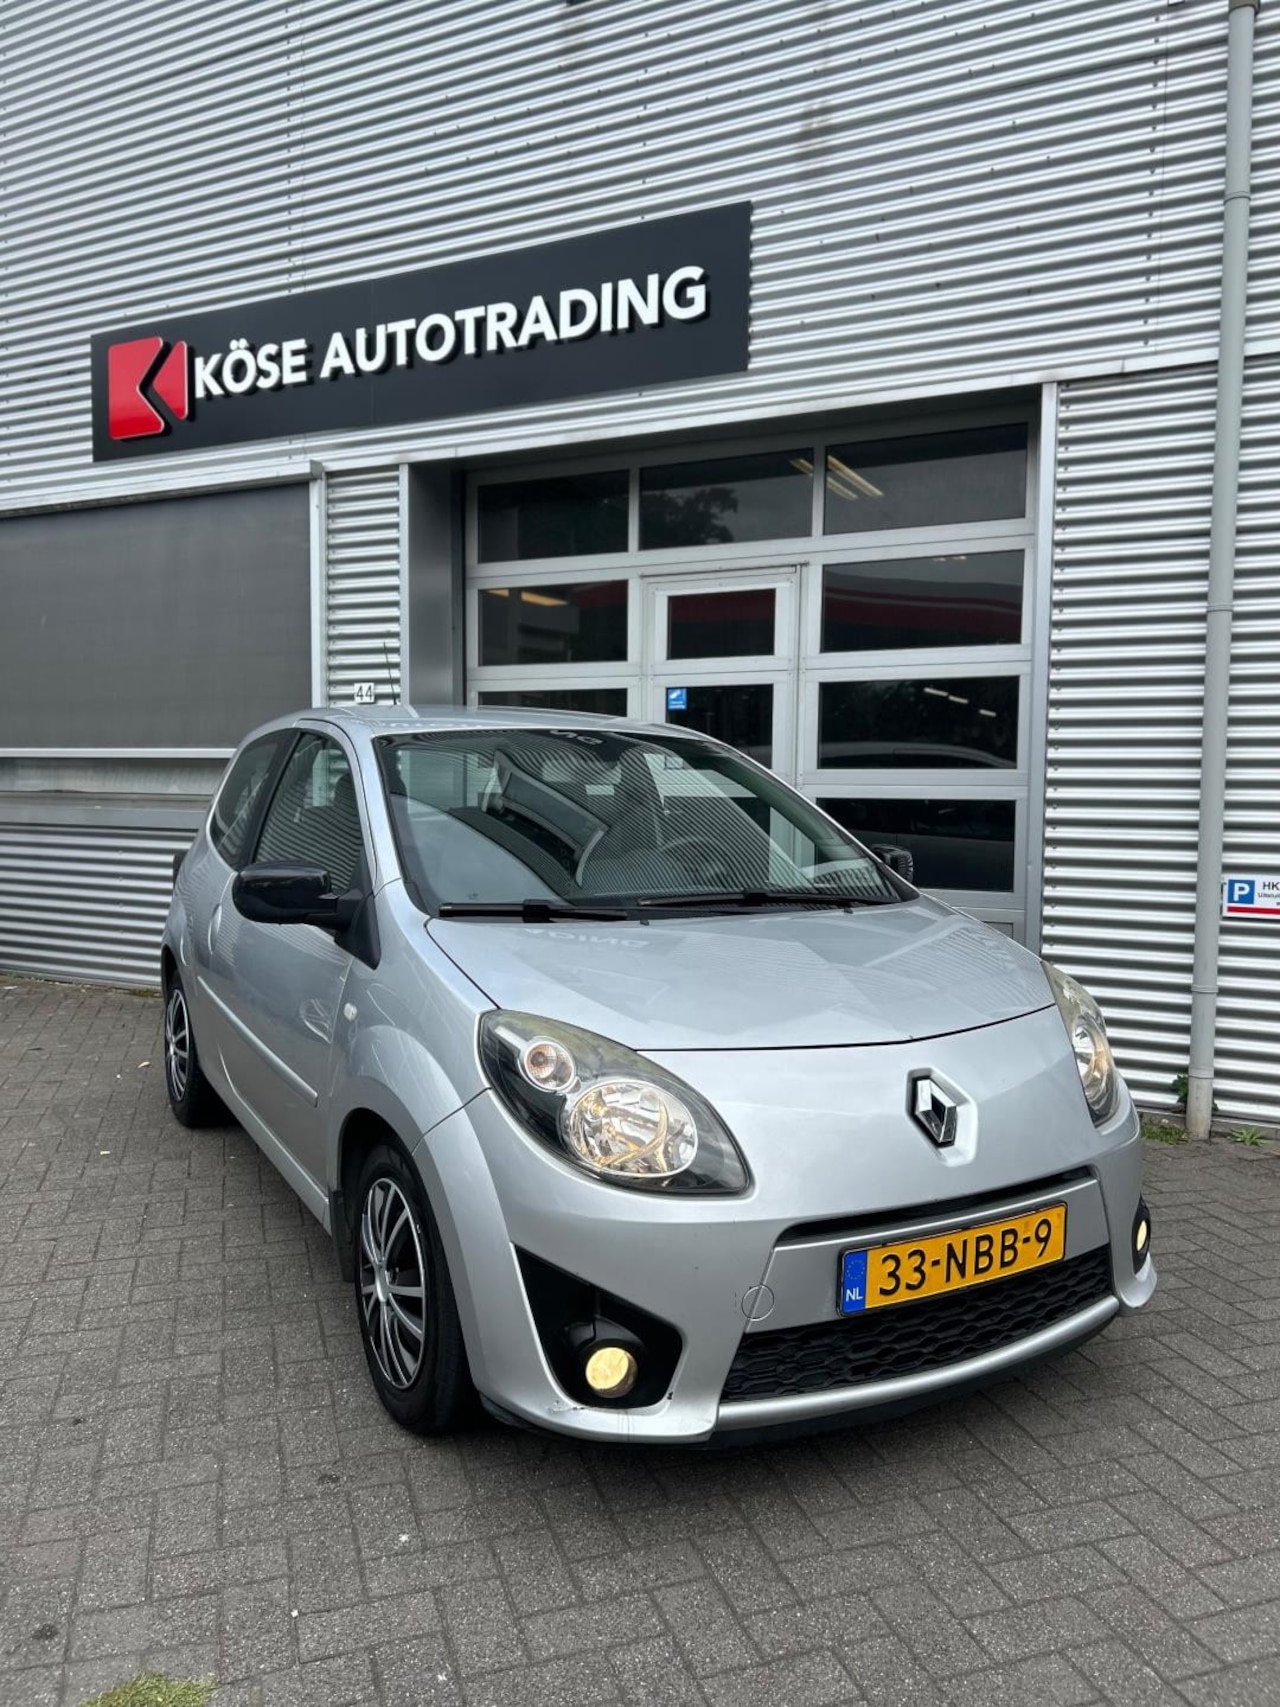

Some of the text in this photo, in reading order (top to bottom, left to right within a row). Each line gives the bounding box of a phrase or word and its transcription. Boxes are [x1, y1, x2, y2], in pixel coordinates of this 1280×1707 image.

[194, 265, 706, 398] KÖSE AUTOTRADING
[356, 685, 373, 701] 44
[1233, 882, 1250, 901] P
[879, 1218, 1052, 1296] 33-NBB-9
[845, 1287, 863, 1302] NL
